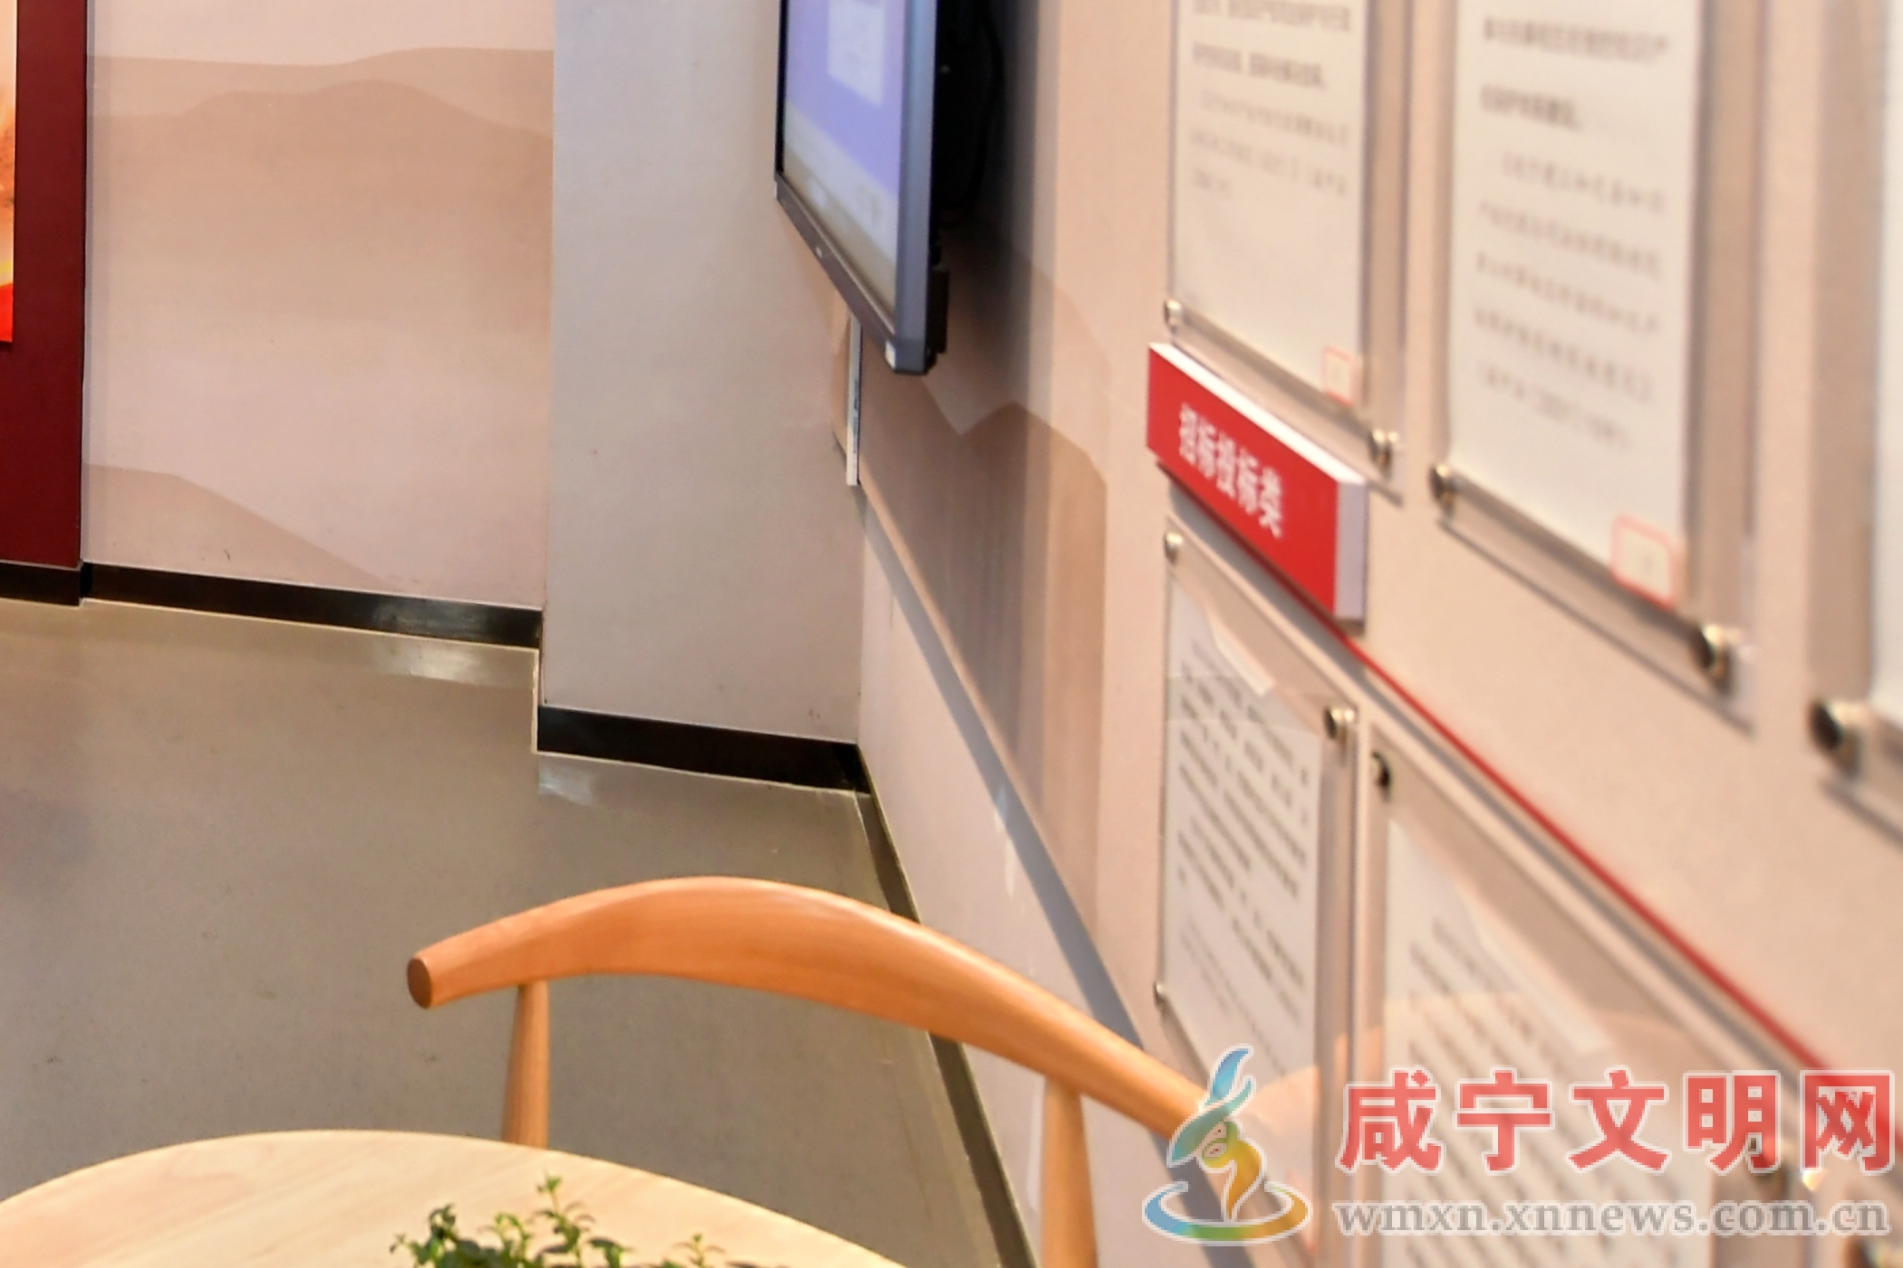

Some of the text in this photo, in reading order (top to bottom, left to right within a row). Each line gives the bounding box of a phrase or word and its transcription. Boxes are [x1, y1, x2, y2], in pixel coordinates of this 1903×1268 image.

[1178, 402, 1284, 541] 招标投标类
